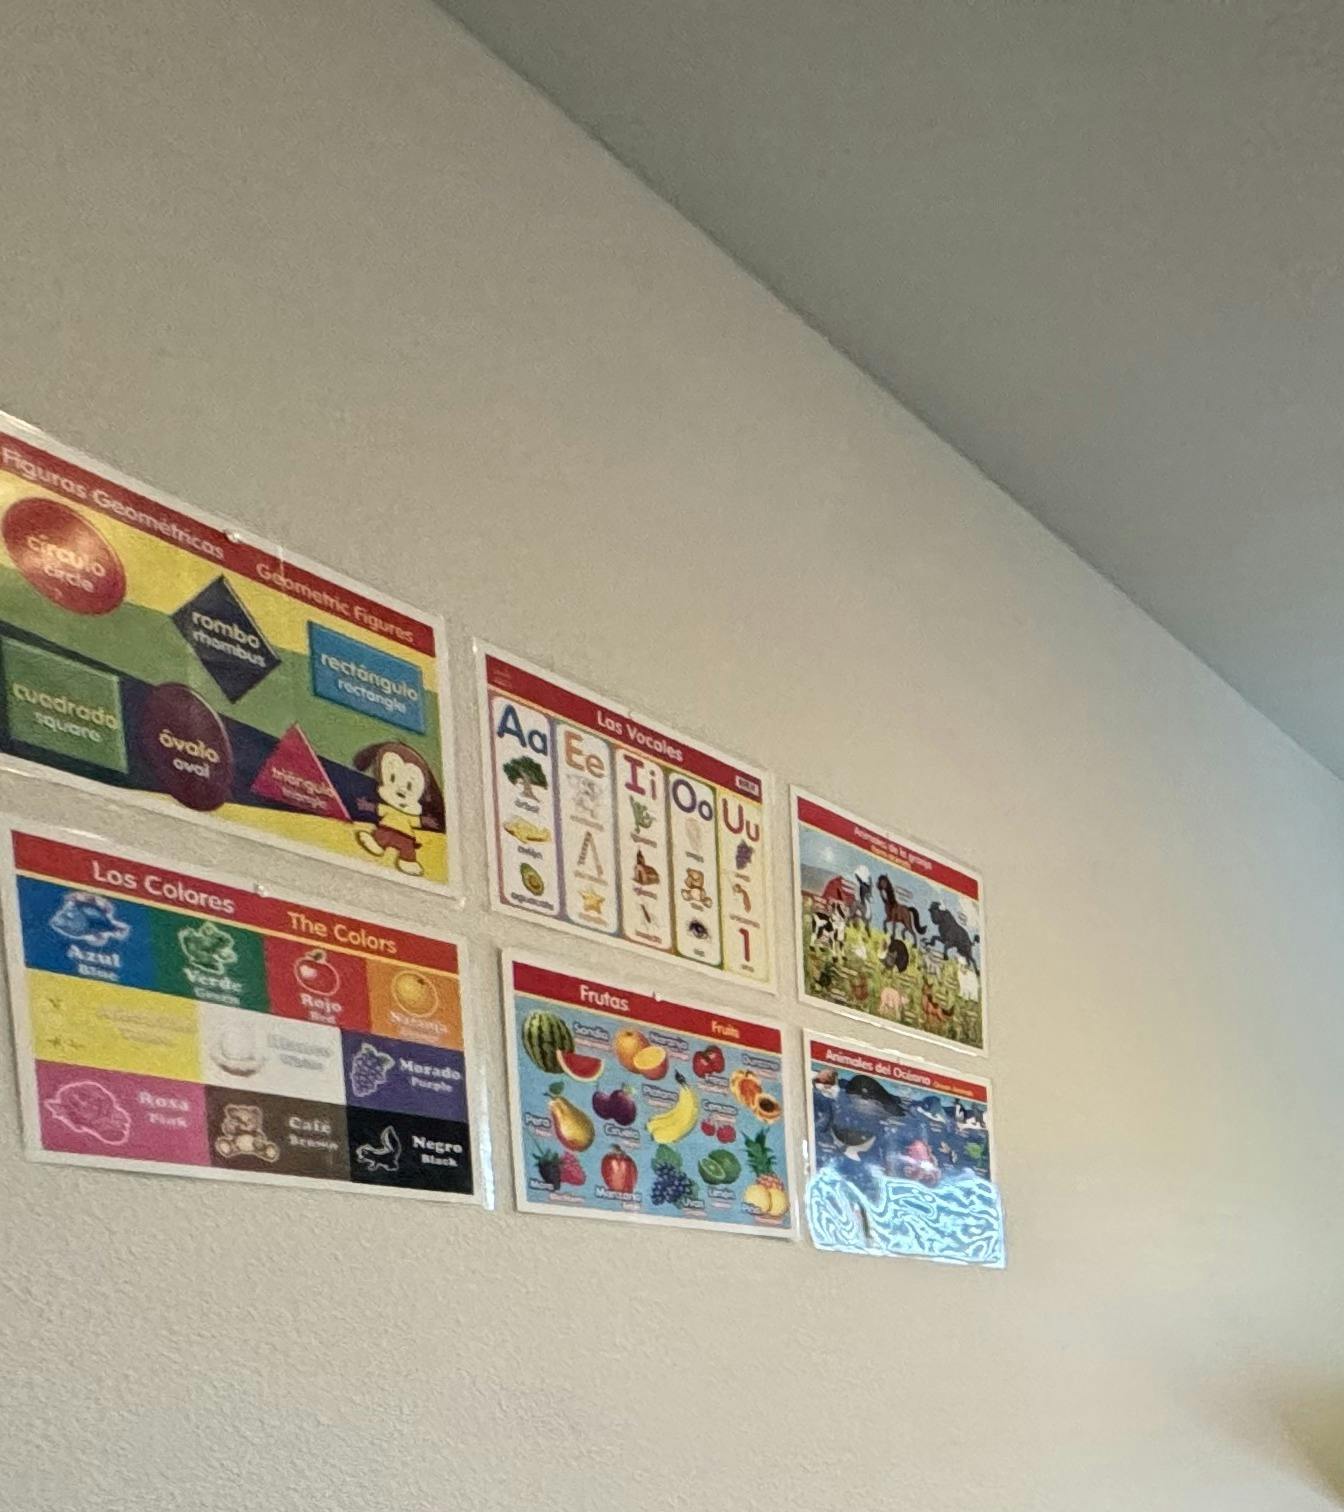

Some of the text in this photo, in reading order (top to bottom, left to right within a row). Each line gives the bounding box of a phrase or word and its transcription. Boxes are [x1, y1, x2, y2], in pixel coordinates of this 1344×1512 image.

[1, 447, 224, 561] Figuras Geométricas
[256, 563, 414, 643] Geometric Figures
[192, 612, 260, 648] rombo
[321, 653, 418, 700] rectángulo
[13, 682, 118, 730] cuadrado
[338, 680, 407, 713] rectangle
[35, 711, 101, 744] square
[497, 704, 549, 757] Aa
[597, 710, 684, 763] Las Vocales
[173, 758, 211, 780] oval
[563, 730, 606, 778] Ee
[623, 753, 657, 801] Ii
[671, 778, 713, 821] Oo
[722, 797, 760, 843] Uu
[92, 860, 236, 916] Los Colores
[288, 910, 398, 955] The Colors
[67, 944, 121, 968] Azul
[183, 967, 243, 993] Verde
[300, 992, 343, 1014] Rojo
[579, 985, 629, 1012] Frutas
[400, 1058, 462, 1081] Morado
[825, 1049, 874, 1072] Animales
[138, 1091, 189, 1113] Rosa
[410, 1077, 453, 1094] Purple
[412, 1135, 463, 1156] Negro
[420, 1154, 458, 1168] Black
